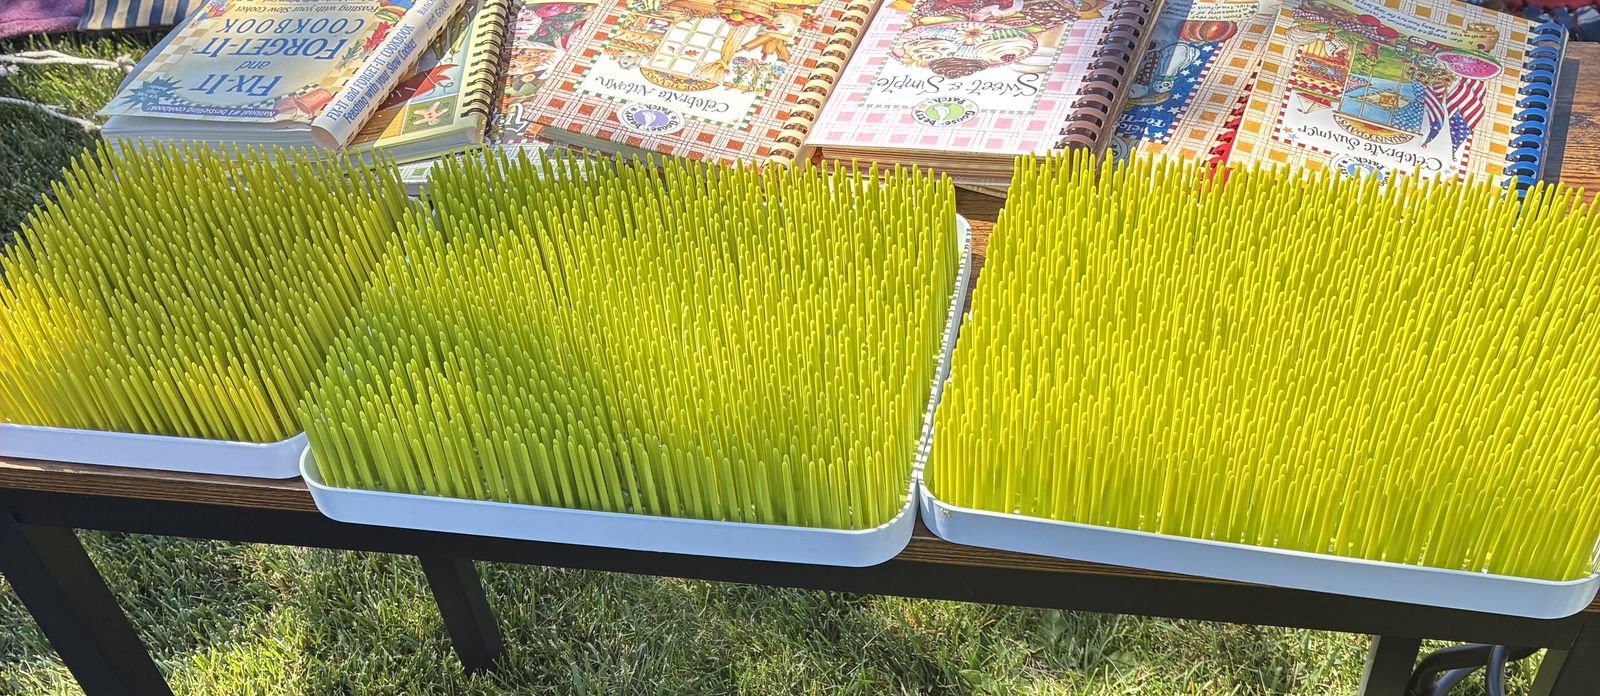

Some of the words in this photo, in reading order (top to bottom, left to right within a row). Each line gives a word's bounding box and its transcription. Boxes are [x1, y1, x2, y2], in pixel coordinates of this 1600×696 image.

[293, 5, 316, 13] your
[315, 5, 337, 13] with
[338, 5, 378, 13] Feasting
[216, 18, 365, 35] COOKBOOK
[426, 13, 437, 30] and
[195, 37, 348, 59] FORGET-IT
[235, 60, 271, 72] and
[344, 86, 360, 102] and
[381, 23, 415, 58] COOKBOOK
[189, 74, 283, 97] FIX-IT
[342, 96, 370, 124] Feasting
[365, 83, 380, 100] with
[376, 70, 391, 90] your
[386, 55, 402, 74] Slow
[398, 38, 417, 60] Cooker
[594, 76, 655, 97] Autumn
[877, 75, 945, 96] Simple
[948, 82, 963, 91] &
[965, 73, 1039, 97] Sweet
[644, 104, 673, 115] Patch
[658, 90, 729, 113] Celebrate
[931, 97, 966, 105] Patch
[186, 106, 229, 116] bestselling
[242, 109, 276, 118] National
[1136, 116, 1167, 128] For
[1297, 126, 1361, 151] Summer
[1353, 156, 1385, 171] Patch
[1362, 142, 1443, 172] Celebrate
